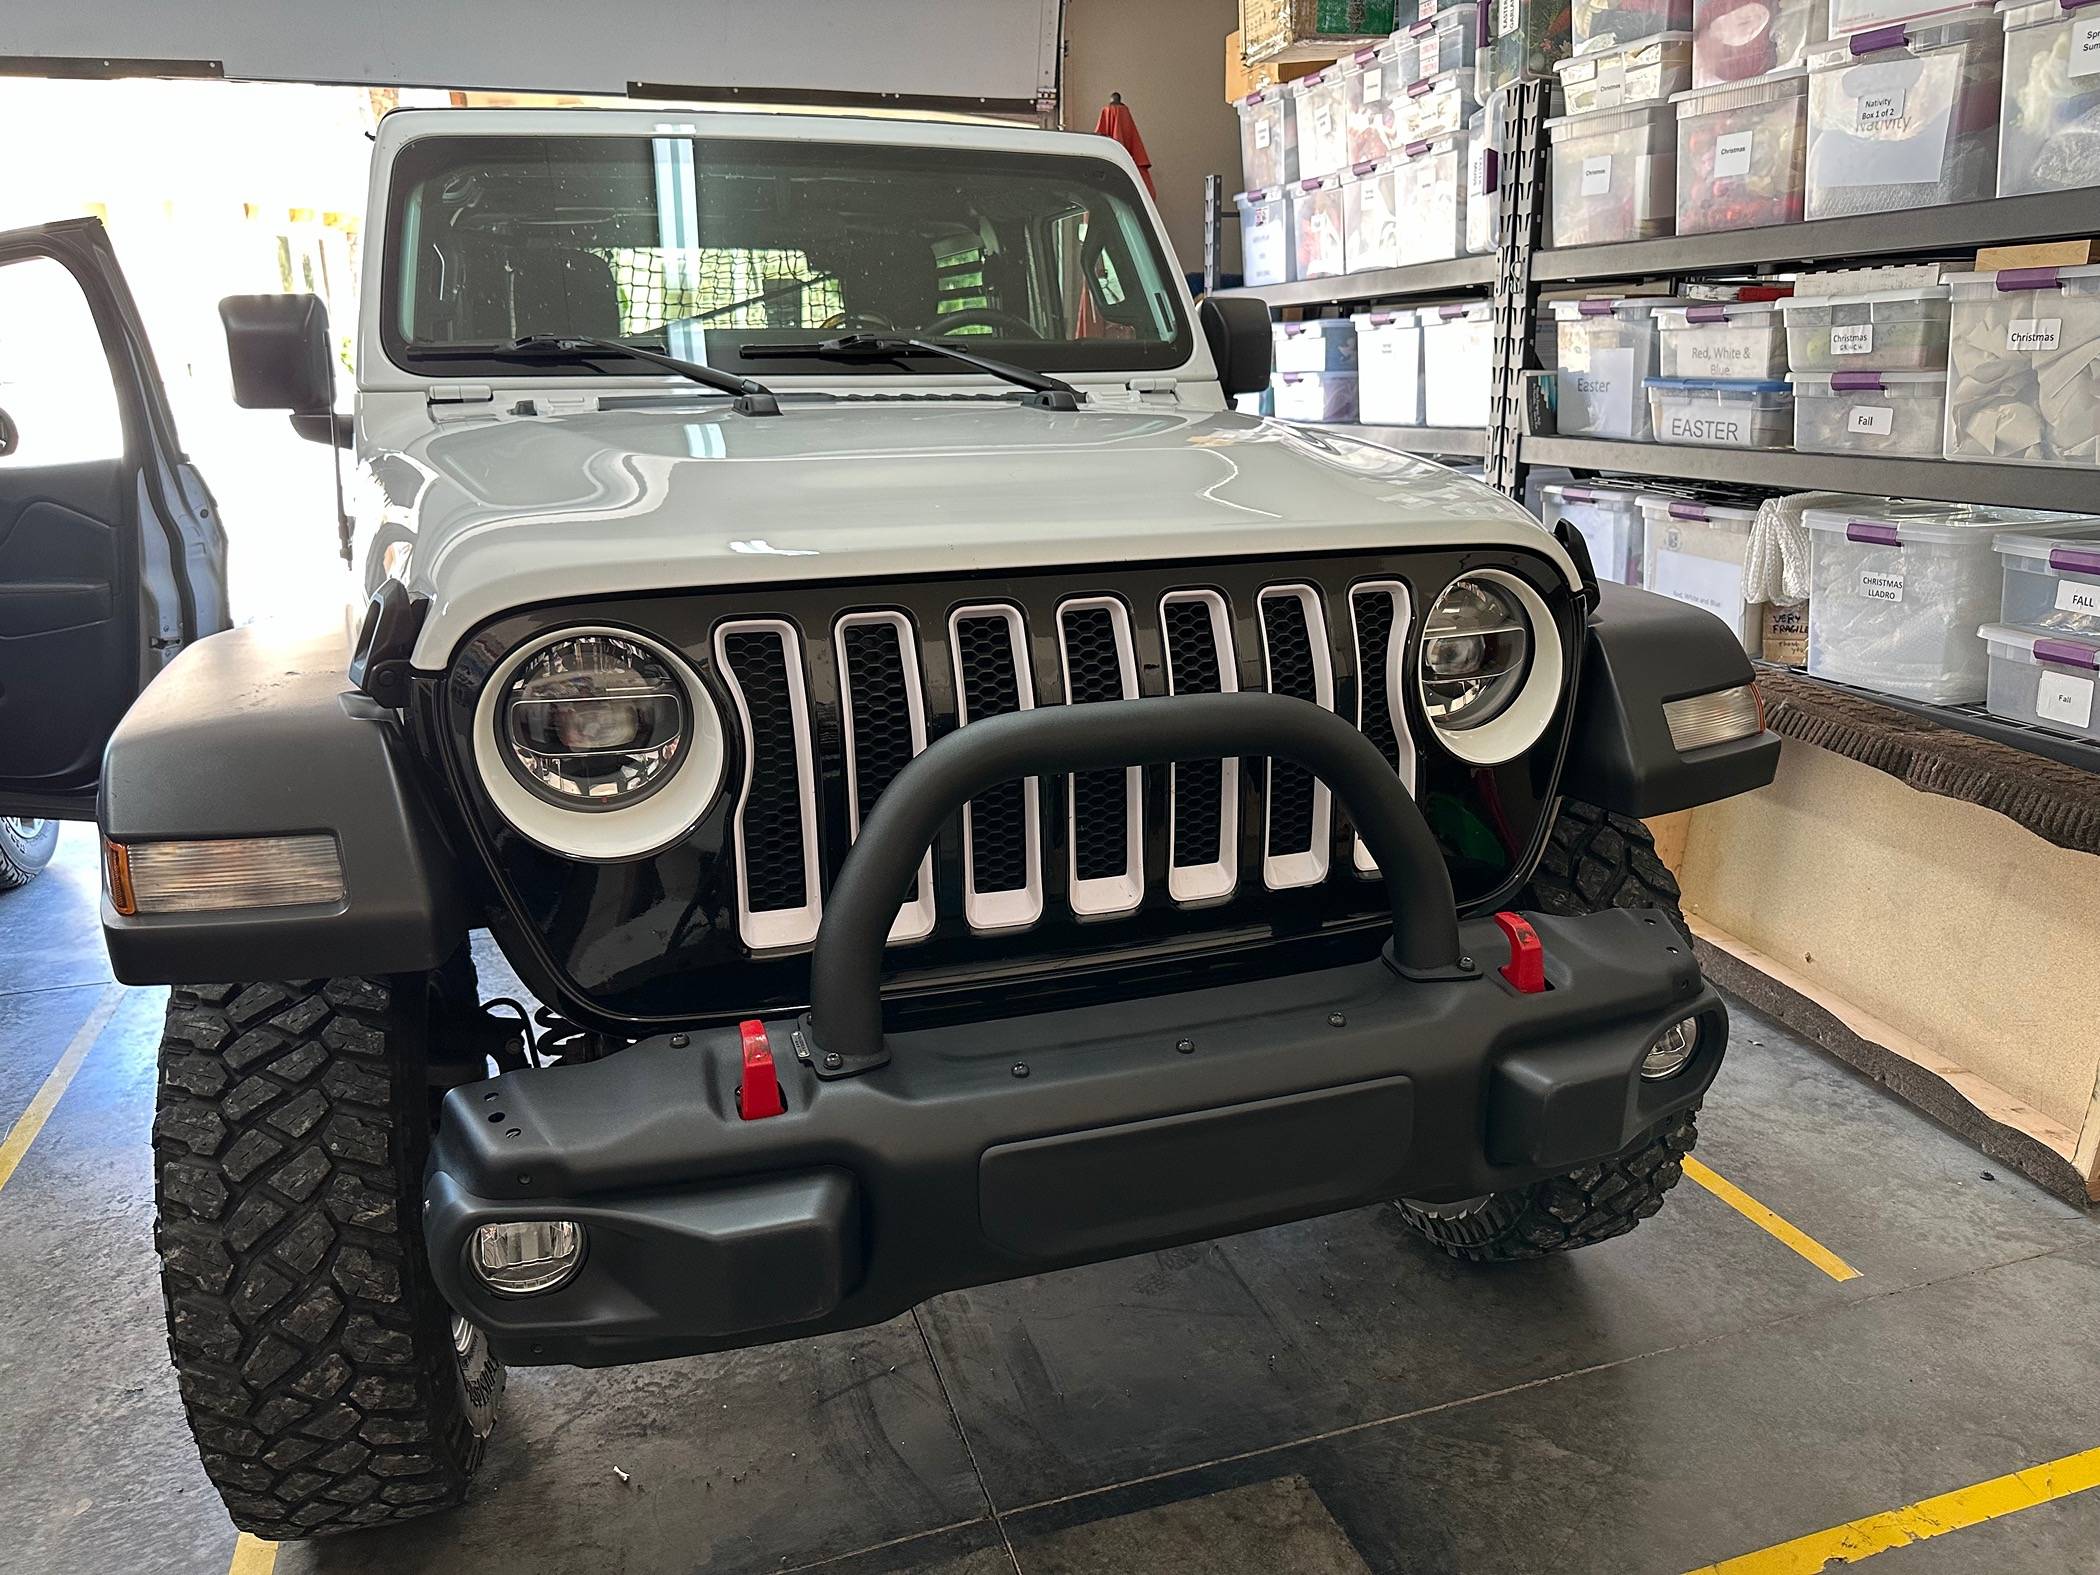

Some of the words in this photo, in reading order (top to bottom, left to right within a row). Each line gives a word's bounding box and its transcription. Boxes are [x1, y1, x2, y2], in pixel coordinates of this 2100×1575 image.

[1865, 98, 1892, 108] Nativity
[1861, 112, 1874, 120] Box
[1881, 109, 1889, 117] of
[1889, 108, 1895, 116] 2
[1720, 146, 1746, 155] Christmas
[1833, 334, 1868, 343] Christmas
[2011, 332, 2055, 342] Christmas
[1691, 347, 1711, 360] Red,
[1714, 347, 1741, 359] White
[1742, 347, 1751, 359] &
[1577, 377, 1611, 393] Easter
[1858, 415, 1873, 426] Fall
[1672, 418, 1738, 441] EASTER
[1862, 576, 1903, 589] CHRISTMAS
[1868, 589, 1896, 600] LLADRO
[2072, 594, 2095, 608] FALL
[1772, 613, 1801, 624] VERY
[2058, 694, 2073, 704] Fall
